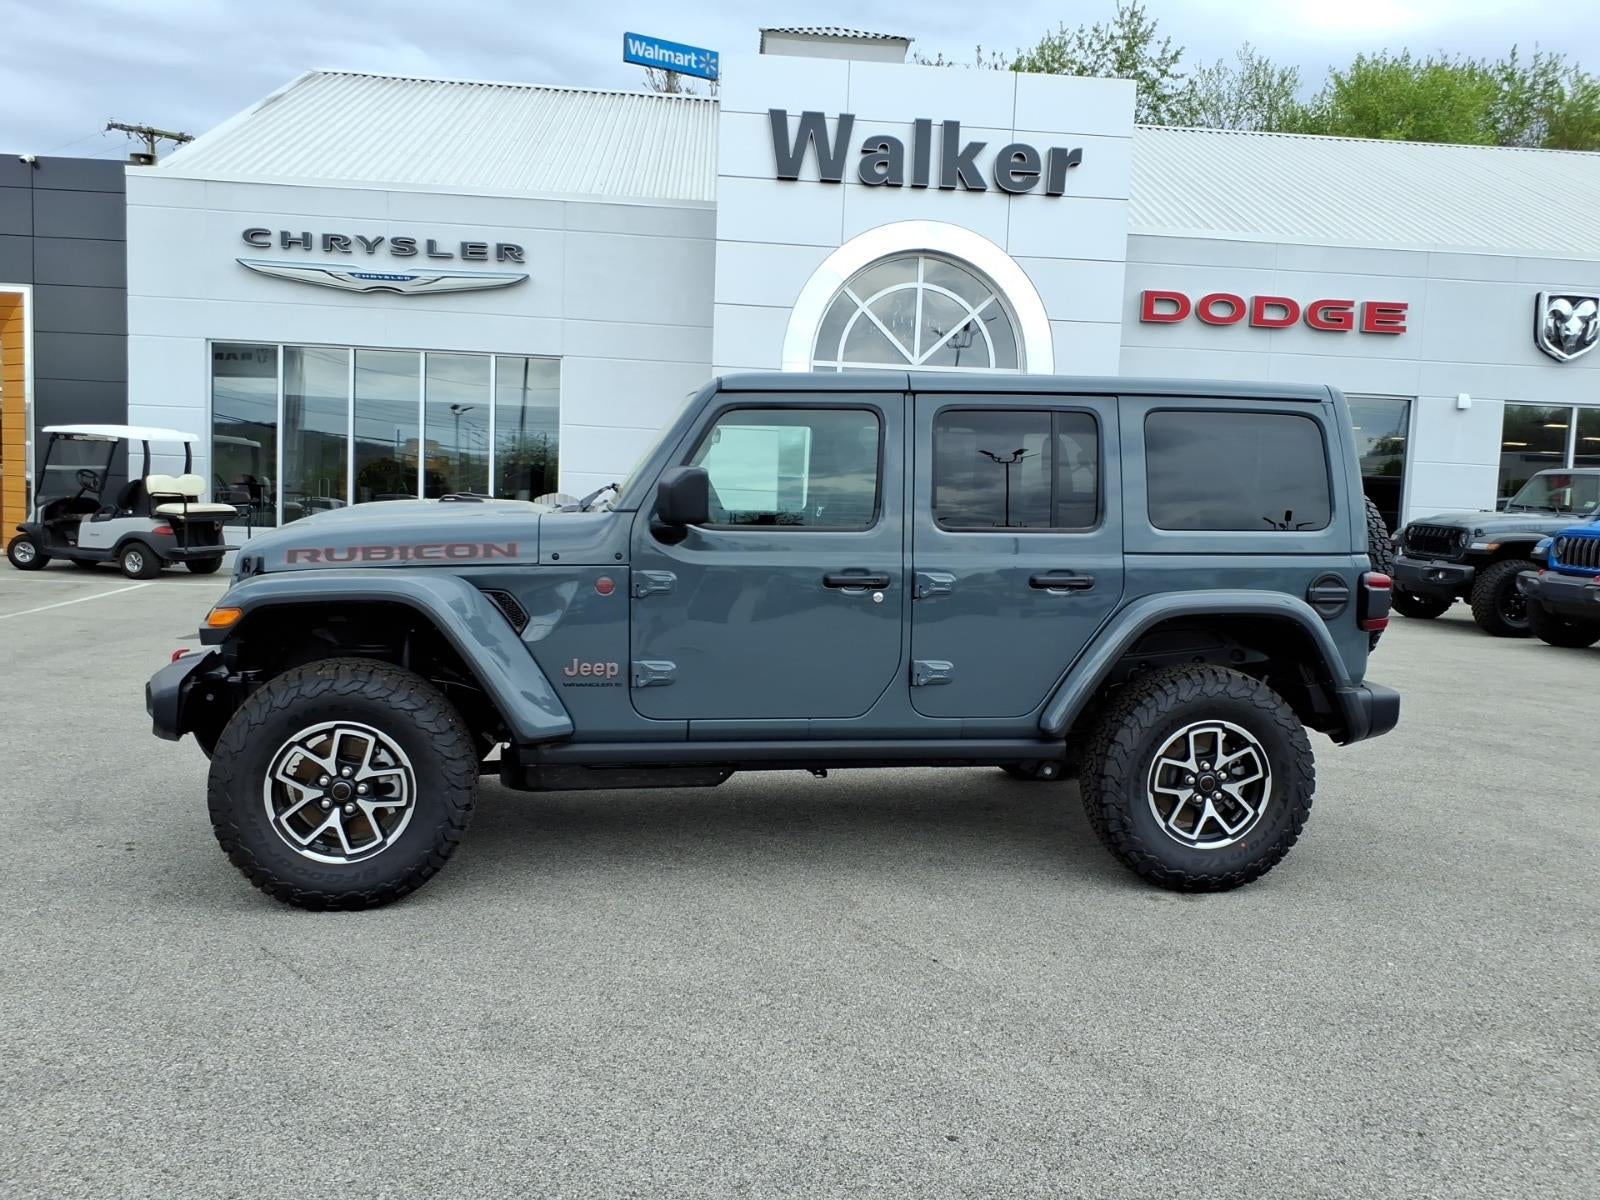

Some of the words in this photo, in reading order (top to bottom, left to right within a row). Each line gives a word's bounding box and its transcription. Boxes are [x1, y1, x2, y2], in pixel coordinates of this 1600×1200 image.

[628, 38, 697, 68] Walmart
[768, 108, 1083, 197] Walker
[242, 227, 526, 263] CHRYSLER
[1140, 289, 1409, 334] DODGE
[285, 541, 518, 565] RUBICON
[563, 657, 619, 679] Jeep
